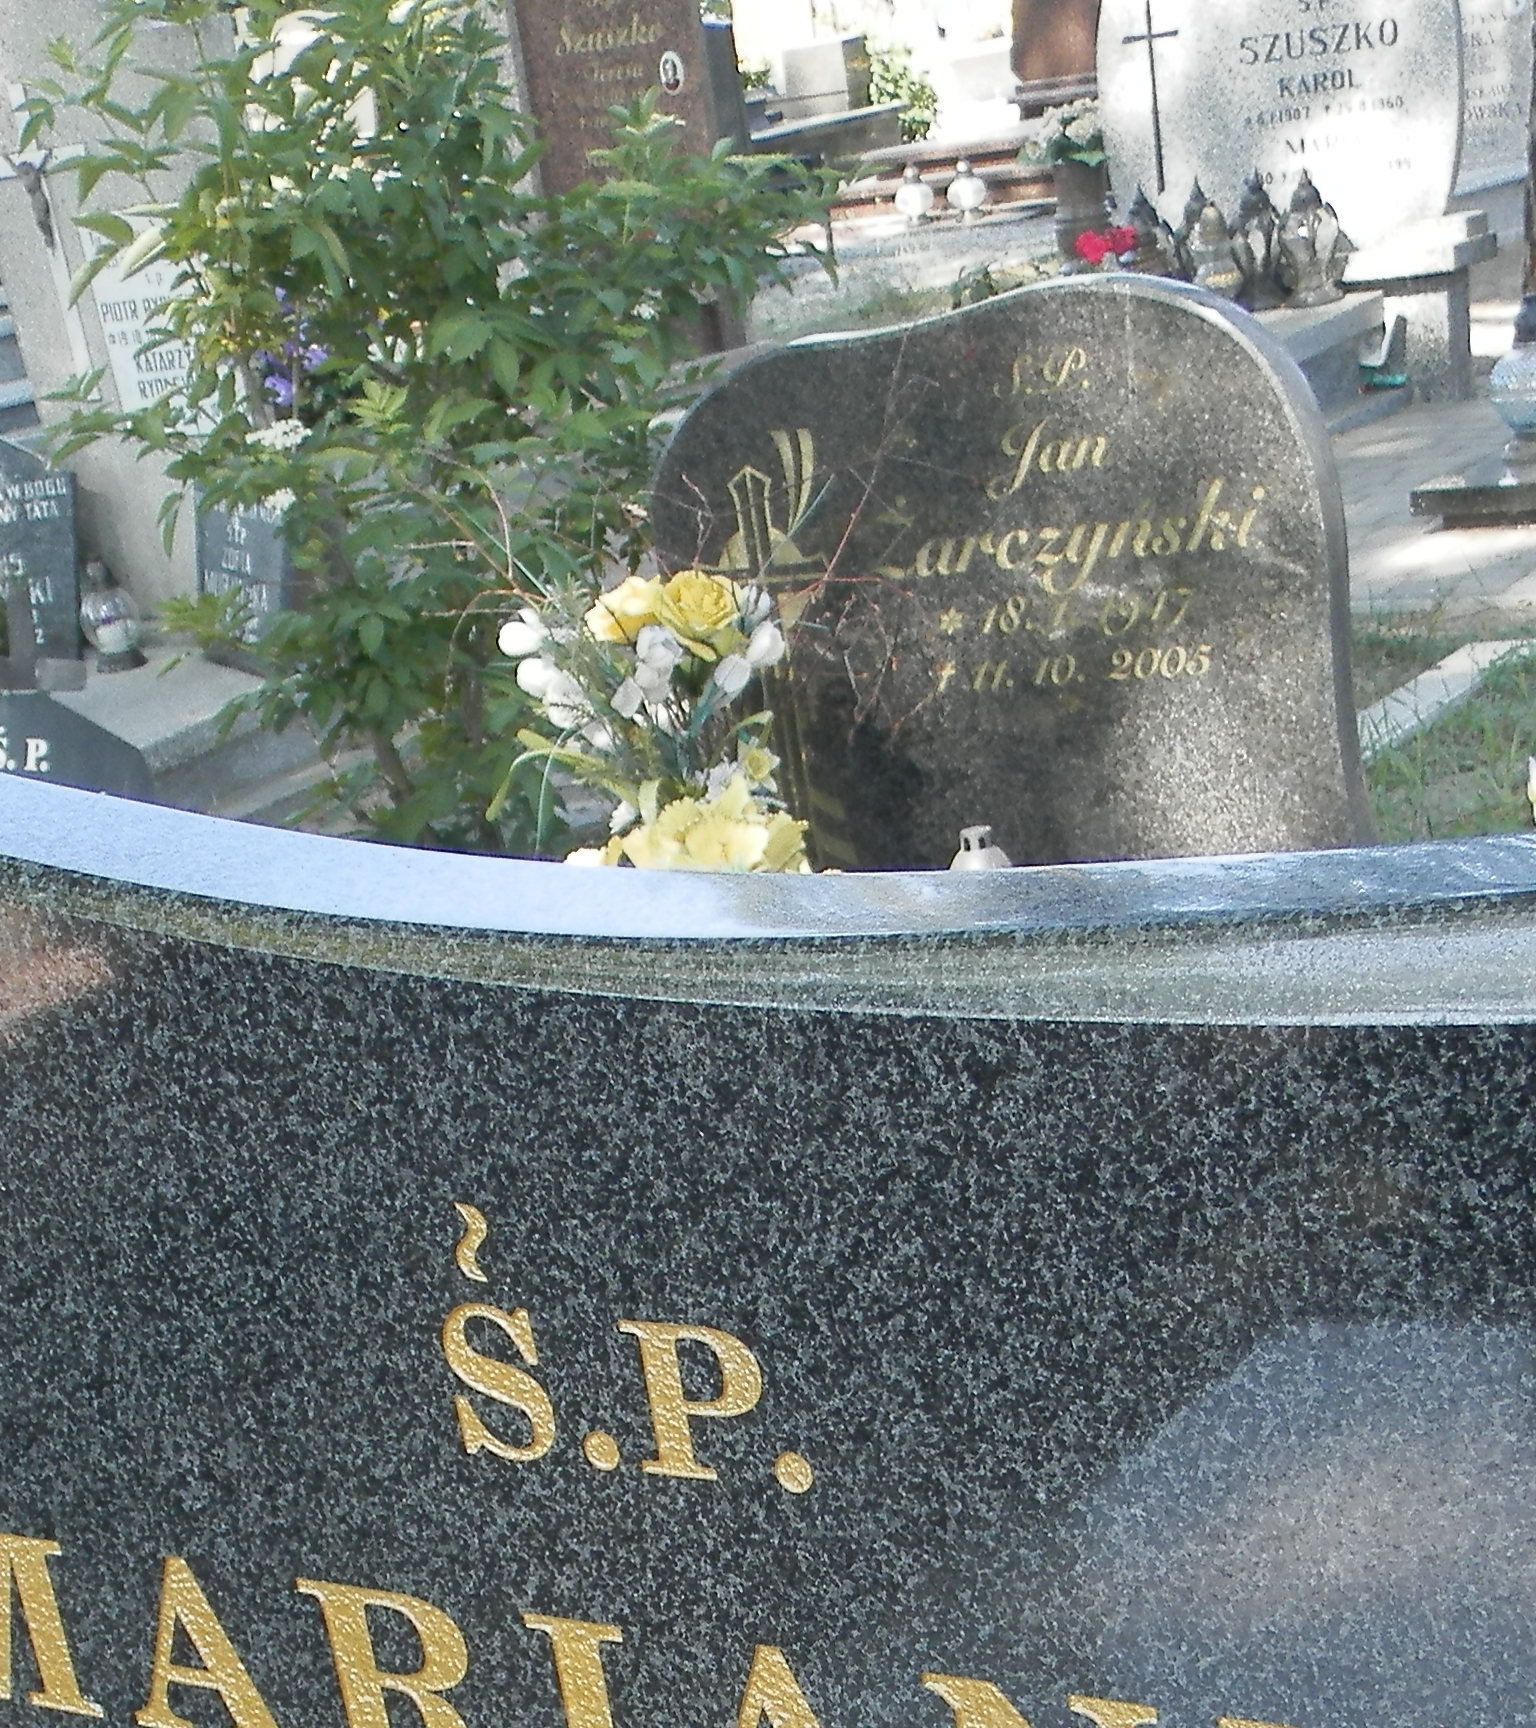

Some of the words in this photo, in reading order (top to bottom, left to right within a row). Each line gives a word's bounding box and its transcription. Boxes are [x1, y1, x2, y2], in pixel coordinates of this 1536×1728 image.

[1240, 18, 1398, 65] SZUSZKO
[1278, 68, 1361, 98] KAROL
[101, 299, 138, 322] PIOTR
[985, 415, 1110, 502] Jan
[24, 500, 60, 521] TATA
[875, 474, 1266, 596] Żarczyński
[1108, 645, 1212, 680] 2005
